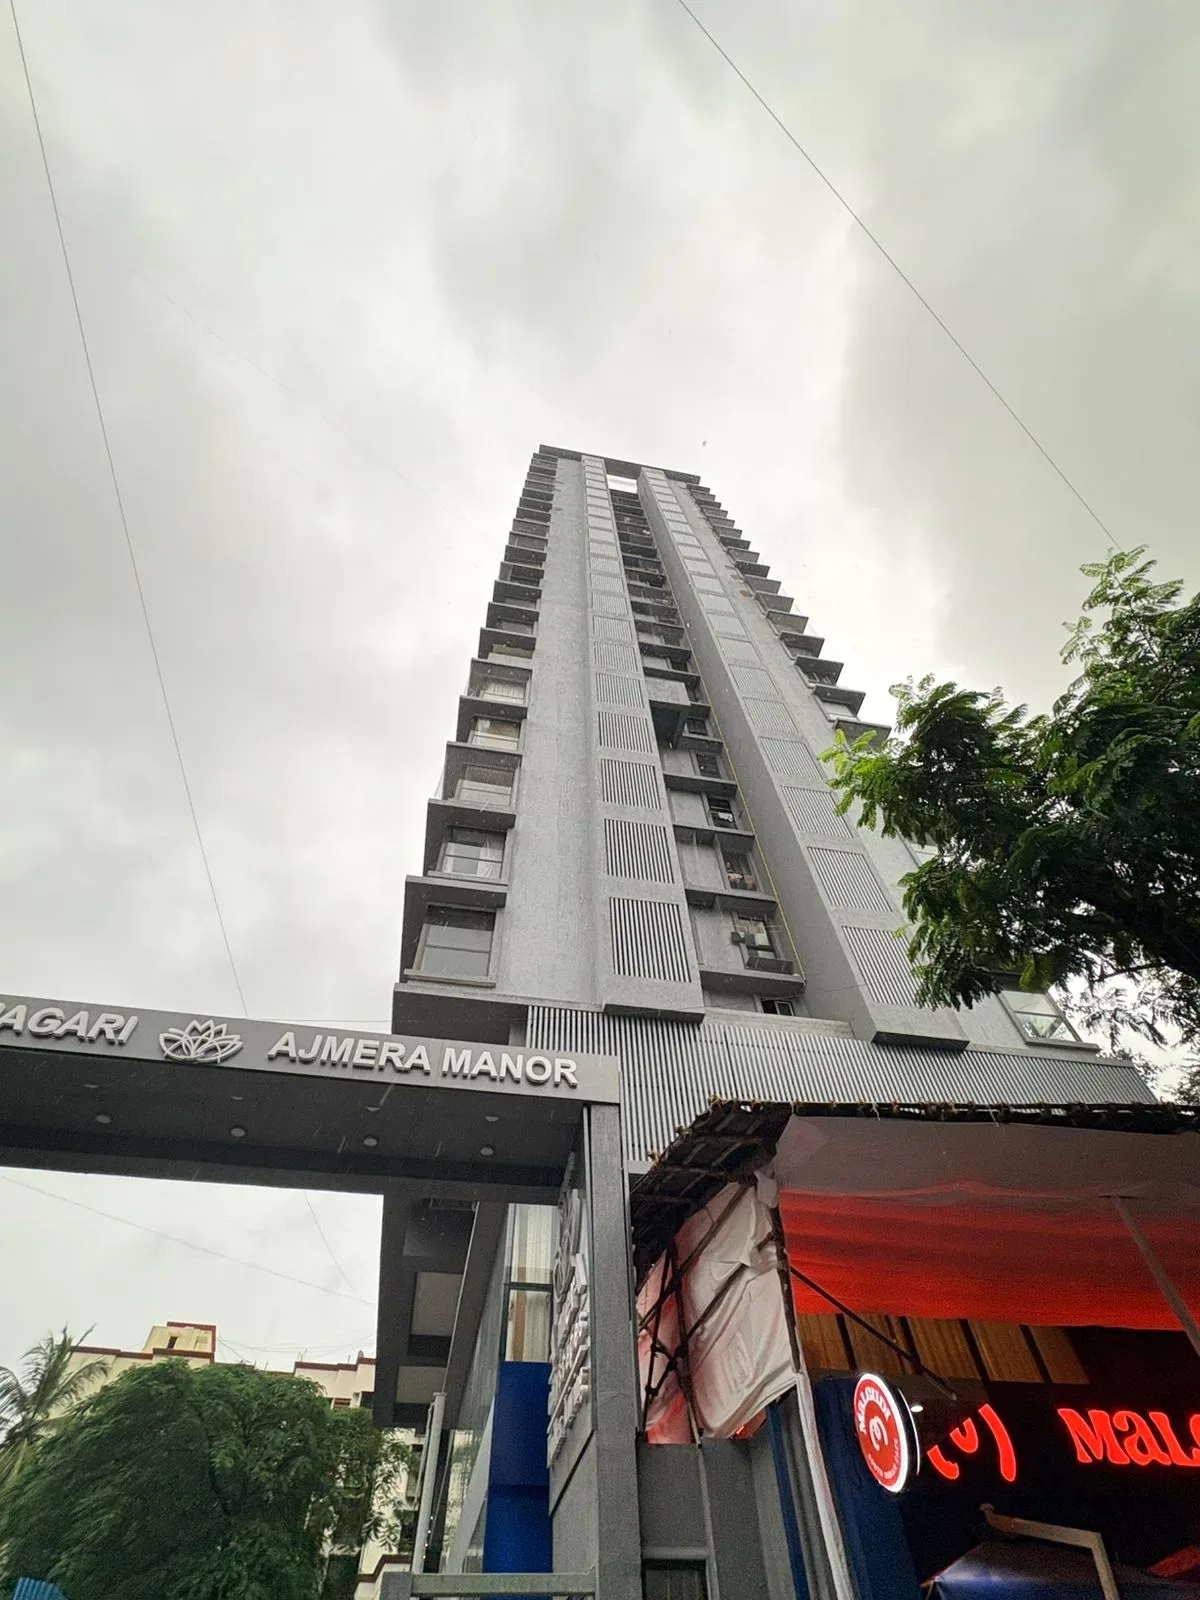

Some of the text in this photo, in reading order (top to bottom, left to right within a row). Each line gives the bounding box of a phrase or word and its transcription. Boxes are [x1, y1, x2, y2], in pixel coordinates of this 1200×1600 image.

[0, 1003, 139, 1044] AGARI
[267, 1031, 578, 1088] AJMERA MANOR
